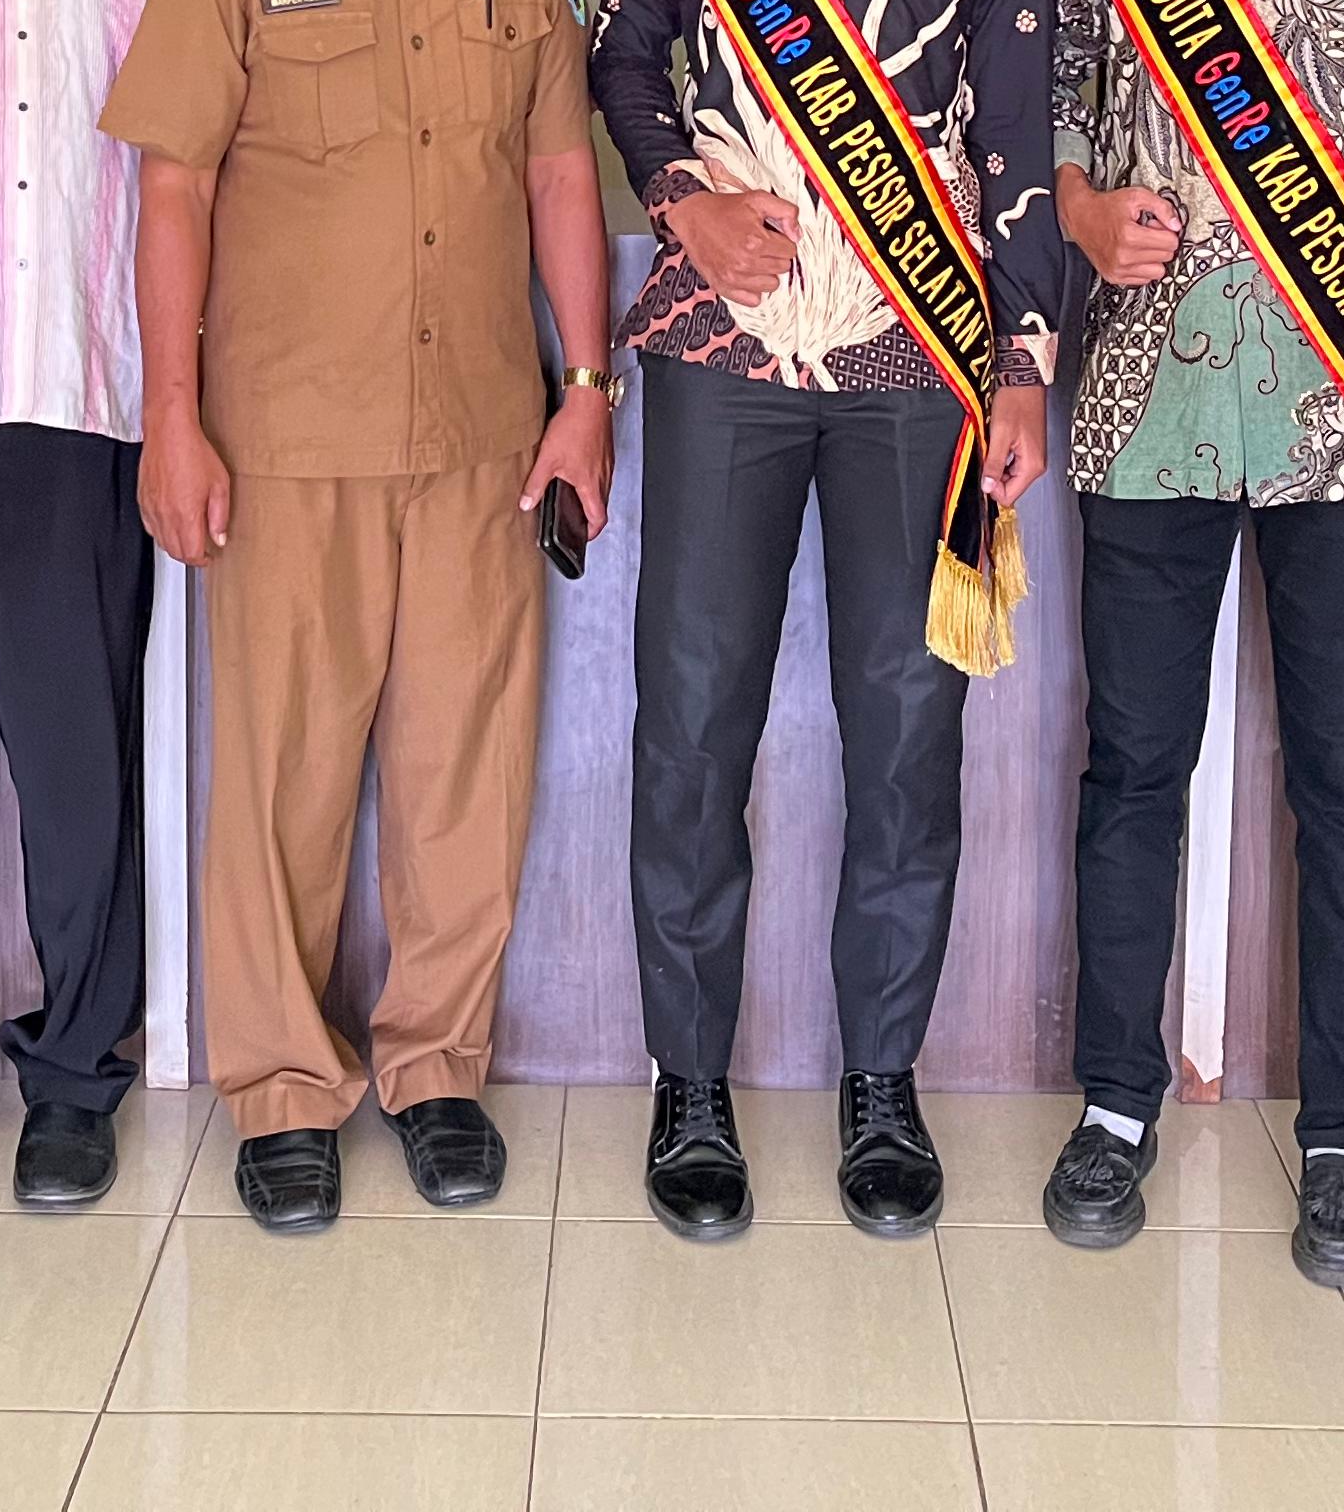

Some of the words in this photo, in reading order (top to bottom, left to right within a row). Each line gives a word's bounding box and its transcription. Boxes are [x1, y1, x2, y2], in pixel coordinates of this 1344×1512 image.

[789, 55, 857, 136] KAB.
[828, 119, 916, 238] PESISIR
[887, 220, 985, 354] SELATAN
[1194, 51, 1270, 152] GenRe
[1248, 142, 1318, 223] KAB.
